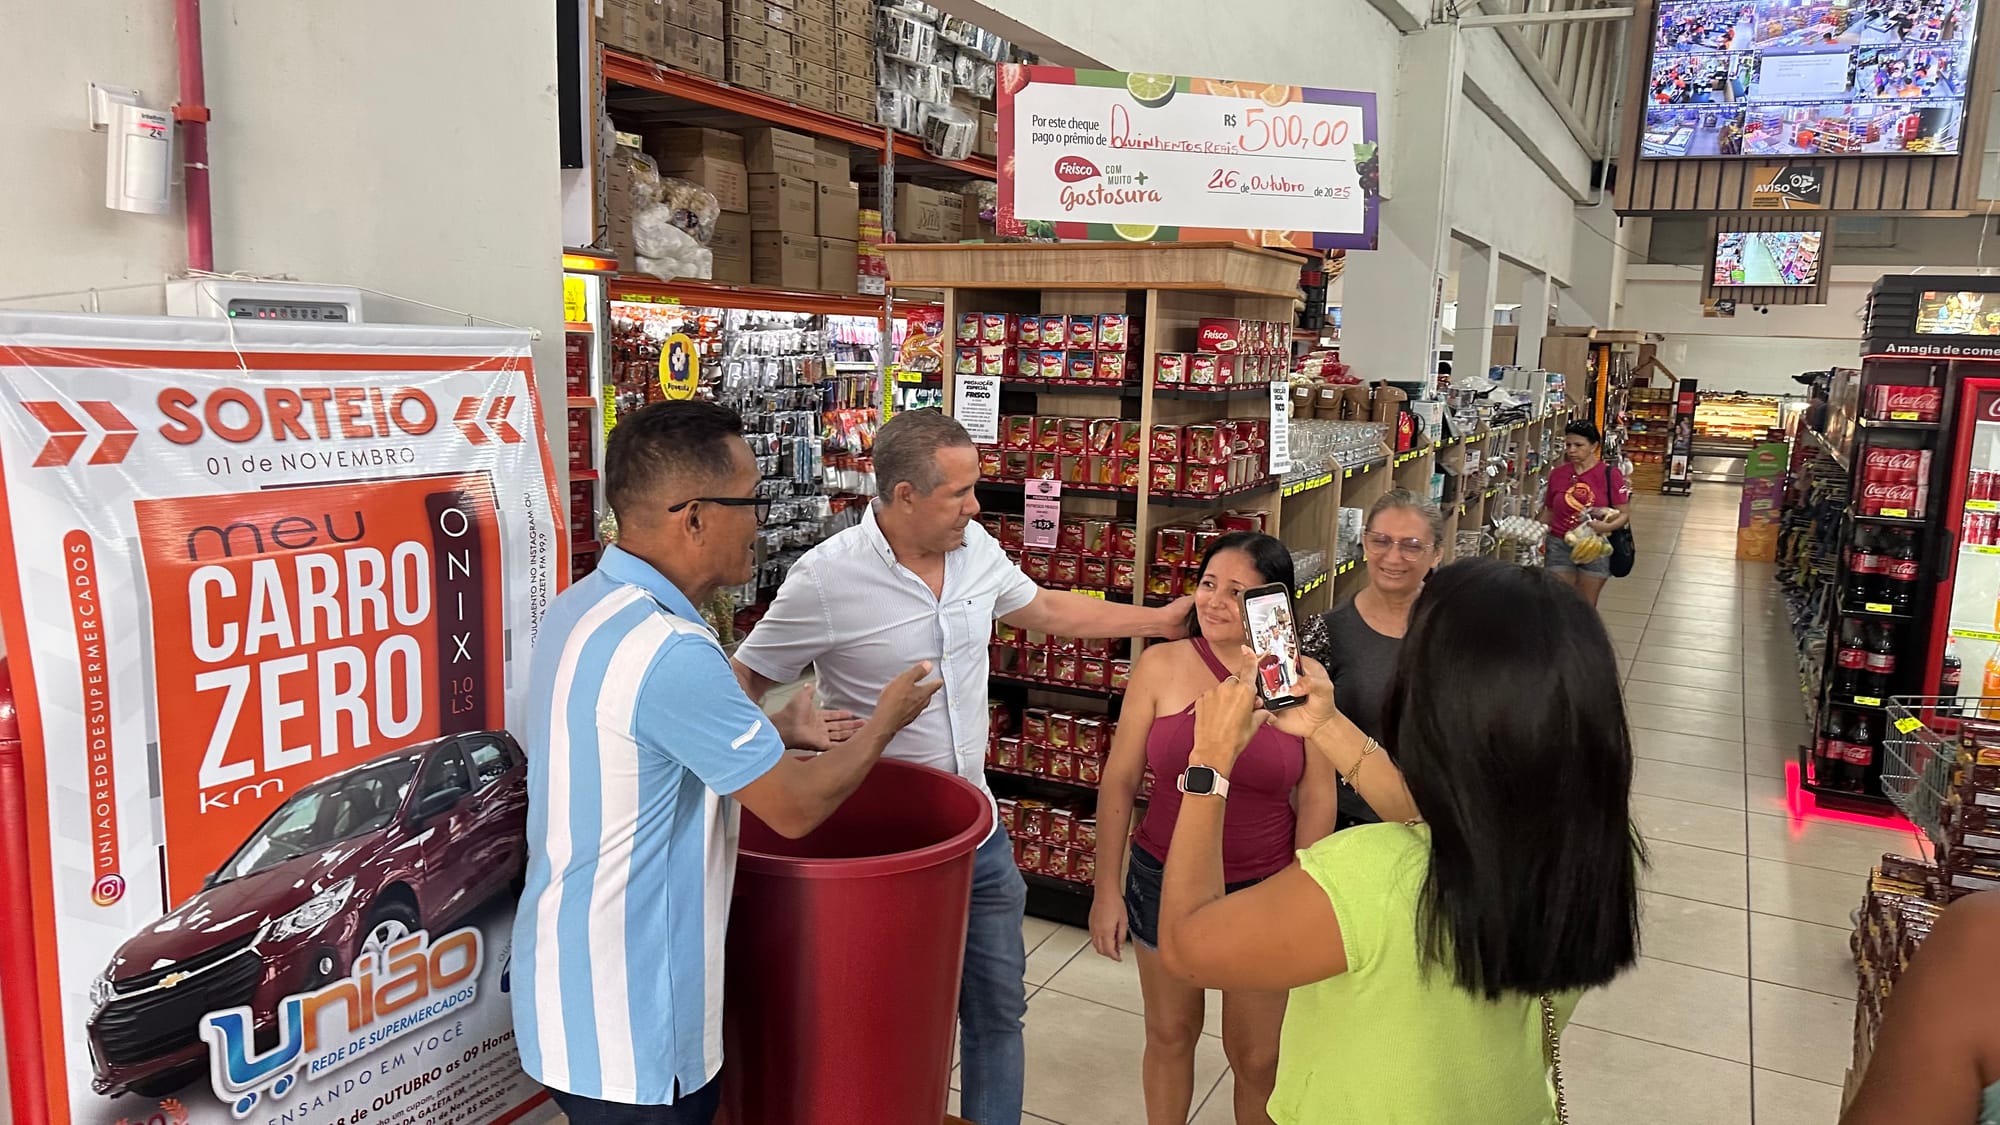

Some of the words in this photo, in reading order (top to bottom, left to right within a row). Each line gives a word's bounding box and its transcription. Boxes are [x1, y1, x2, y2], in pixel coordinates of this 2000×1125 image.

[1032, 114, 1047, 128] Por
[1048, 117, 1067, 129] este
[1067, 117, 1100, 131] cheque
[1238, 108, 1349, 152] 500,00
[1032, 132, 1054, 146] pago
[1055, 134, 1062, 144] o
[1063, 132, 1095, 146] prêmio
[1096, 133, 1107, 146] de
[1105, 165, 1122, 175] COM
[1107, 175, 1132, 185] MUITO
[1208, 168, 1241, 189] 26
[1240, 185, 1250, 194] de
[1314, 187, 1323, 197] de
[1755, 184, 1790, 192] AVISO
[1203, 330, 1228, 340] Frisco
[1886, 344, 1897, 353] A
[1897, 344, 1940, 356] magia
[1942, 345, 1960, 355] de
[965, 391, 991, 399] FRISCO
[157, 387, 438, 445] SORTEIO
[207, 456, 232, 475] 01
[242, 455, 272, 473] de
[282, 447, 415, 471] NOVEMBRO
[524, 493, 532, 508] OU
[528, 514, 538, 565] INSTAGRAM
[539, 533, 548, 553] 99,9
[531, 567, 538, 583] NO
[539, 555, 547, 570] FM
[439, 507, 472, 664] ONIX
[539, 572, 547, 607] GAZETA
[188, 541, 431, 663] CARRO
[71, 543, 114, 868] UNIAOREDEDESUPERMERCADOS
[195, 634, 423, 789] ZERO
[200, 778, 284, 814] km
[311, 1048, 345, 1074] REDE
[349, 1036, 366, 1056] DE
[369, 986, 474, 1045] SUPERMERCADOS
[268, 1070, 372, 1125] ENSANDO
[381, 1053, 406, 1075] EM
[413, 1021, 464, 1057] VOCÊ
[350, 1101, 368, 1125] de
[372, 1066, 441, 1112] OUTUBRO
[446, 1059, 460, 1074] as
[463, 1044, 479, 1063] 09
[418, 1095, 452, 1119] GAZETA
[438, 1110, 448, 1121] de
[449, 1087, 489, 1114] Novembro
